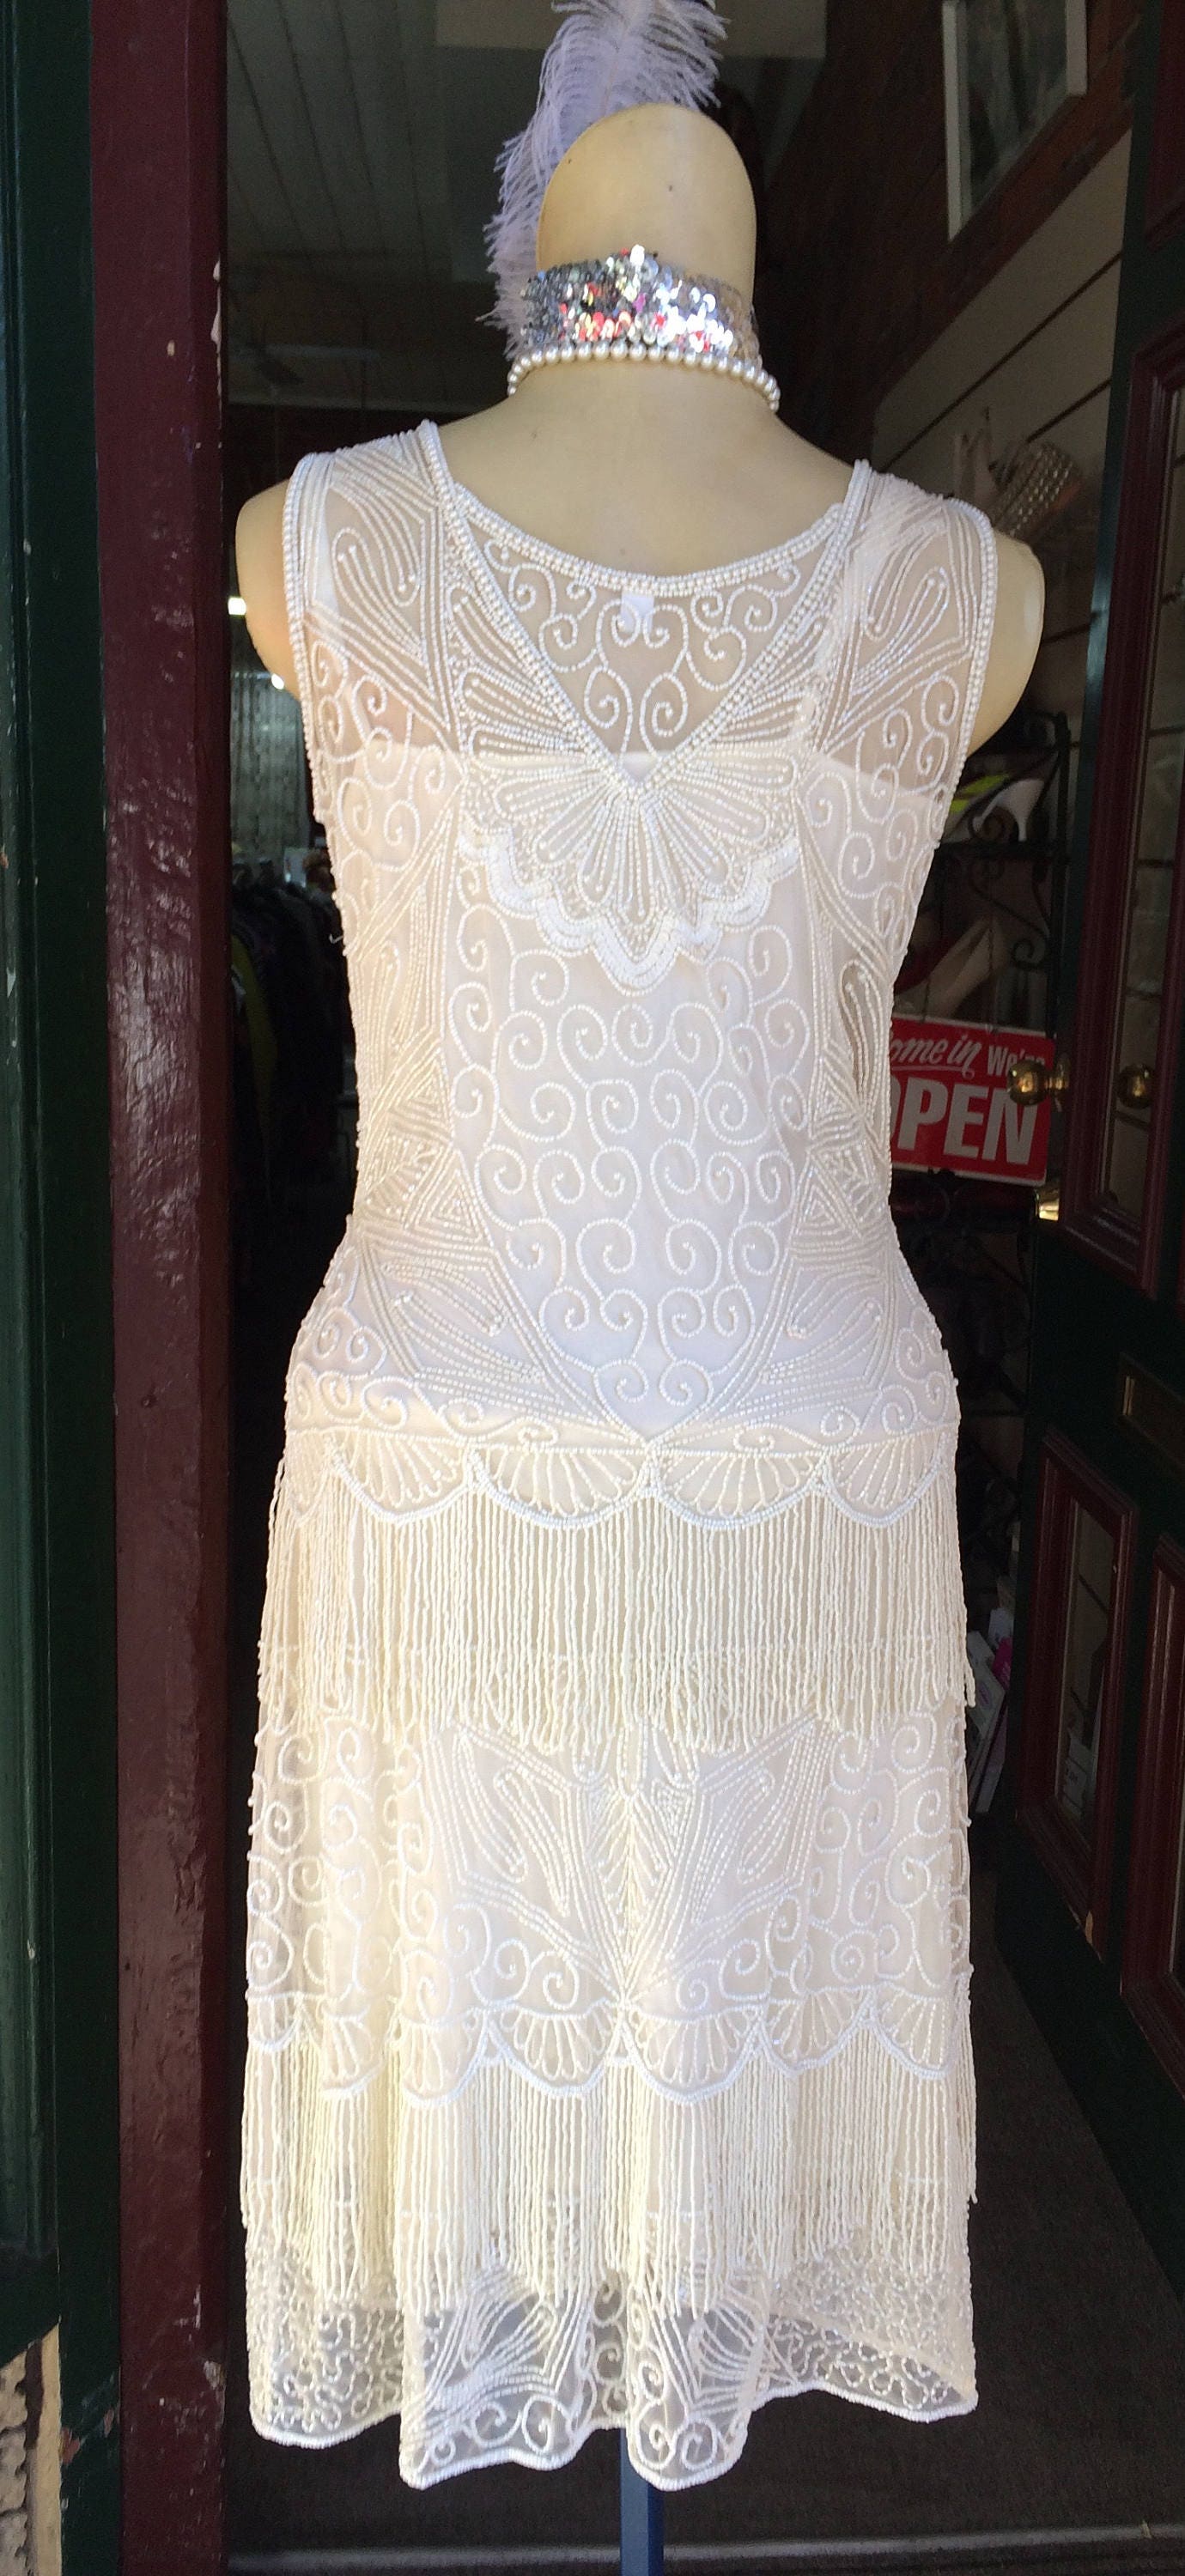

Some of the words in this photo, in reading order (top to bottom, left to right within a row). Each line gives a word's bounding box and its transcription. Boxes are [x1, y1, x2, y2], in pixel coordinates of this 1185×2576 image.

[890, 1035, 948, 1063] ome
[946, 1034, 982, 1079] in
[988, 1044, 1045, 1076] We'
[890, 1074, 1037, 1164] PEN
